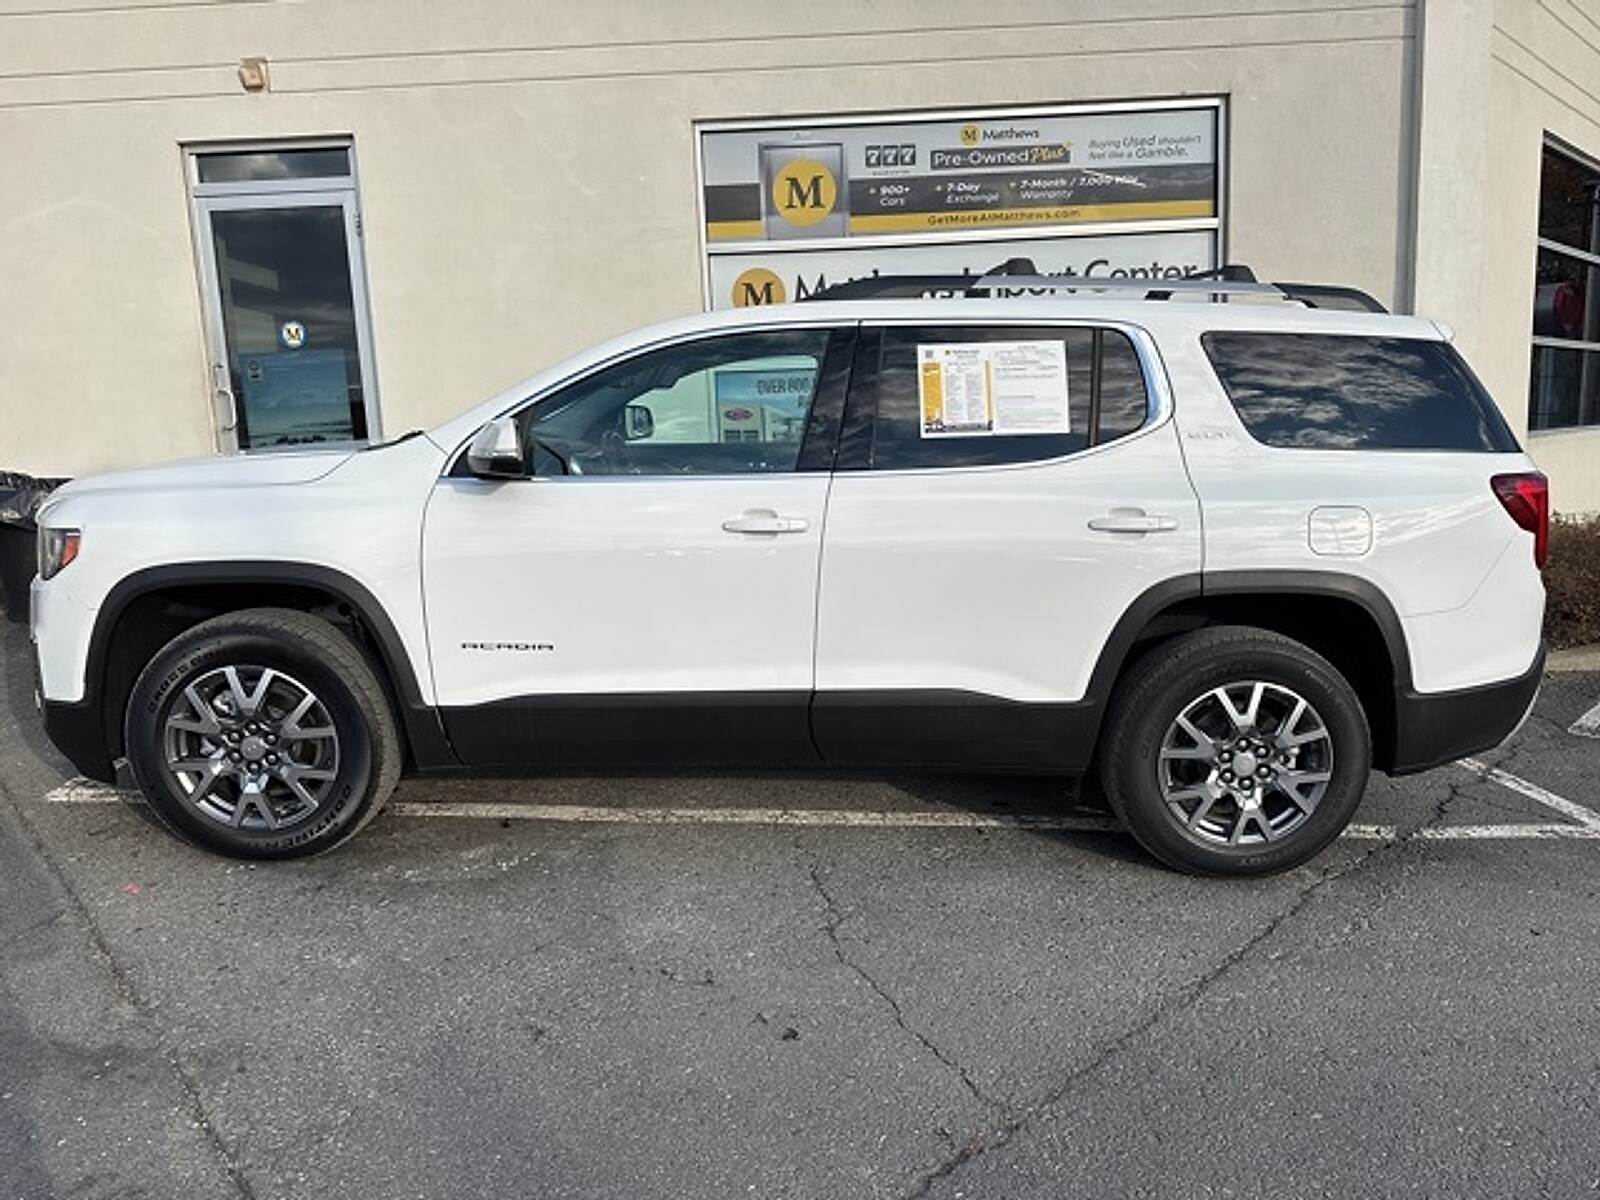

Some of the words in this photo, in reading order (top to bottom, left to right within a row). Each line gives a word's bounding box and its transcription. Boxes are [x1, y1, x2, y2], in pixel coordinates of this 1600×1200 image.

[982, 128, 1039, 141] Matthews
[1122, 134, 1156, 147] Used
[933, 151, 1029, 167] Pre-Owned
[785, 175, 825, 208] M
[742, 282, 773, 308] M
[461, 641, 554, 651] ACADIA
